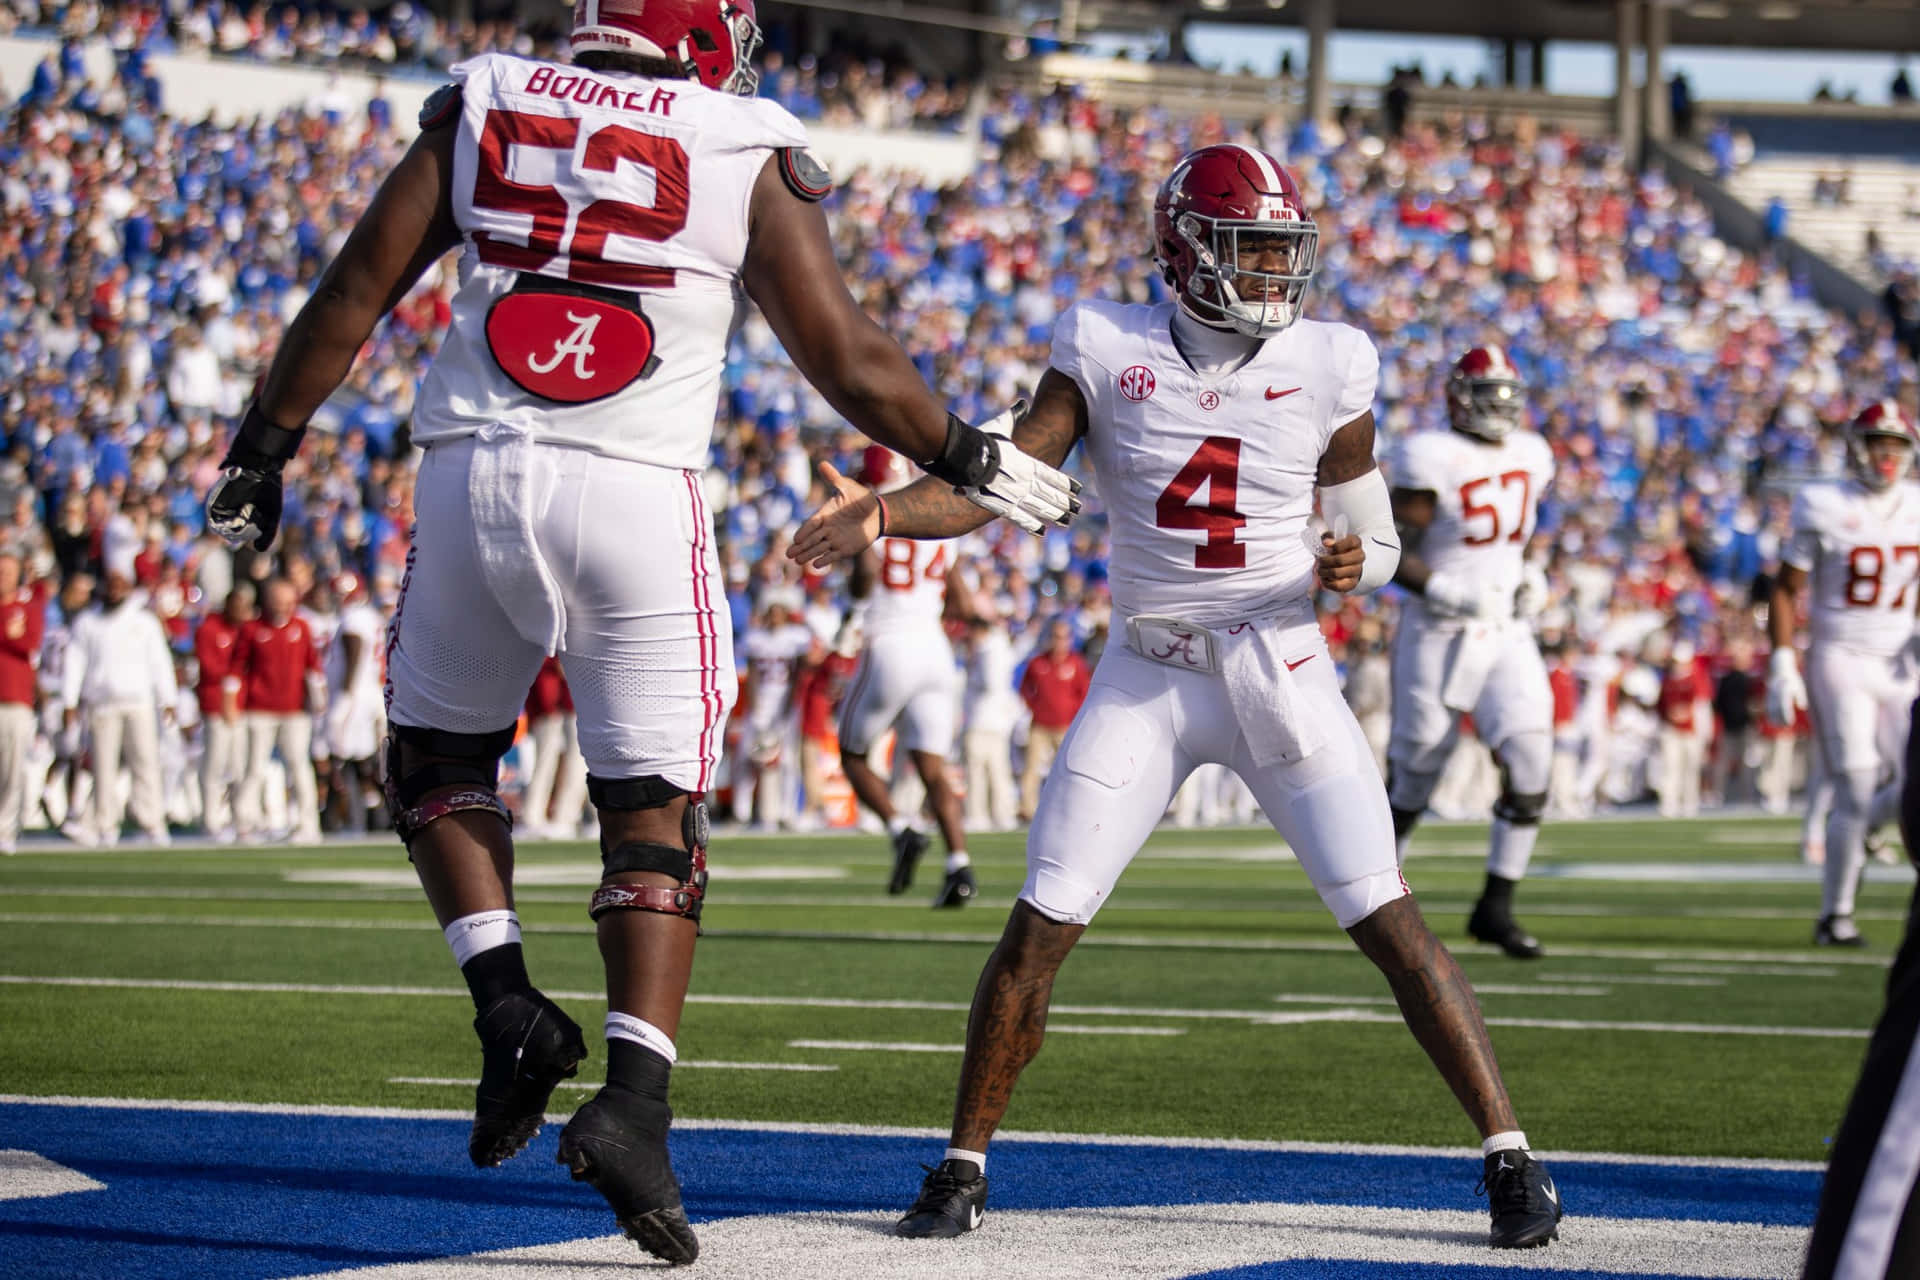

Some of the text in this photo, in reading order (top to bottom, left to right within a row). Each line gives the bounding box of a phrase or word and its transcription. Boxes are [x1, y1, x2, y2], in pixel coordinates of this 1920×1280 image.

[603, 33, 632, 48] TIDE
[525, 67, 679, 117] BOOKER
[471, 108, 690, 289] 52
[1168, 164, 1193, 205] 4
[1269, 209, 1293, 221] BAMA
[528, 310, 602, 380] A
[1121, 367, 1154, 400] SEC
[1155, 436, 1247, 568] 4
[1459, 470, 1530, 546] 57
[883, 538, 948, 600] 84
[1847, 545, 1920, 610] 87
